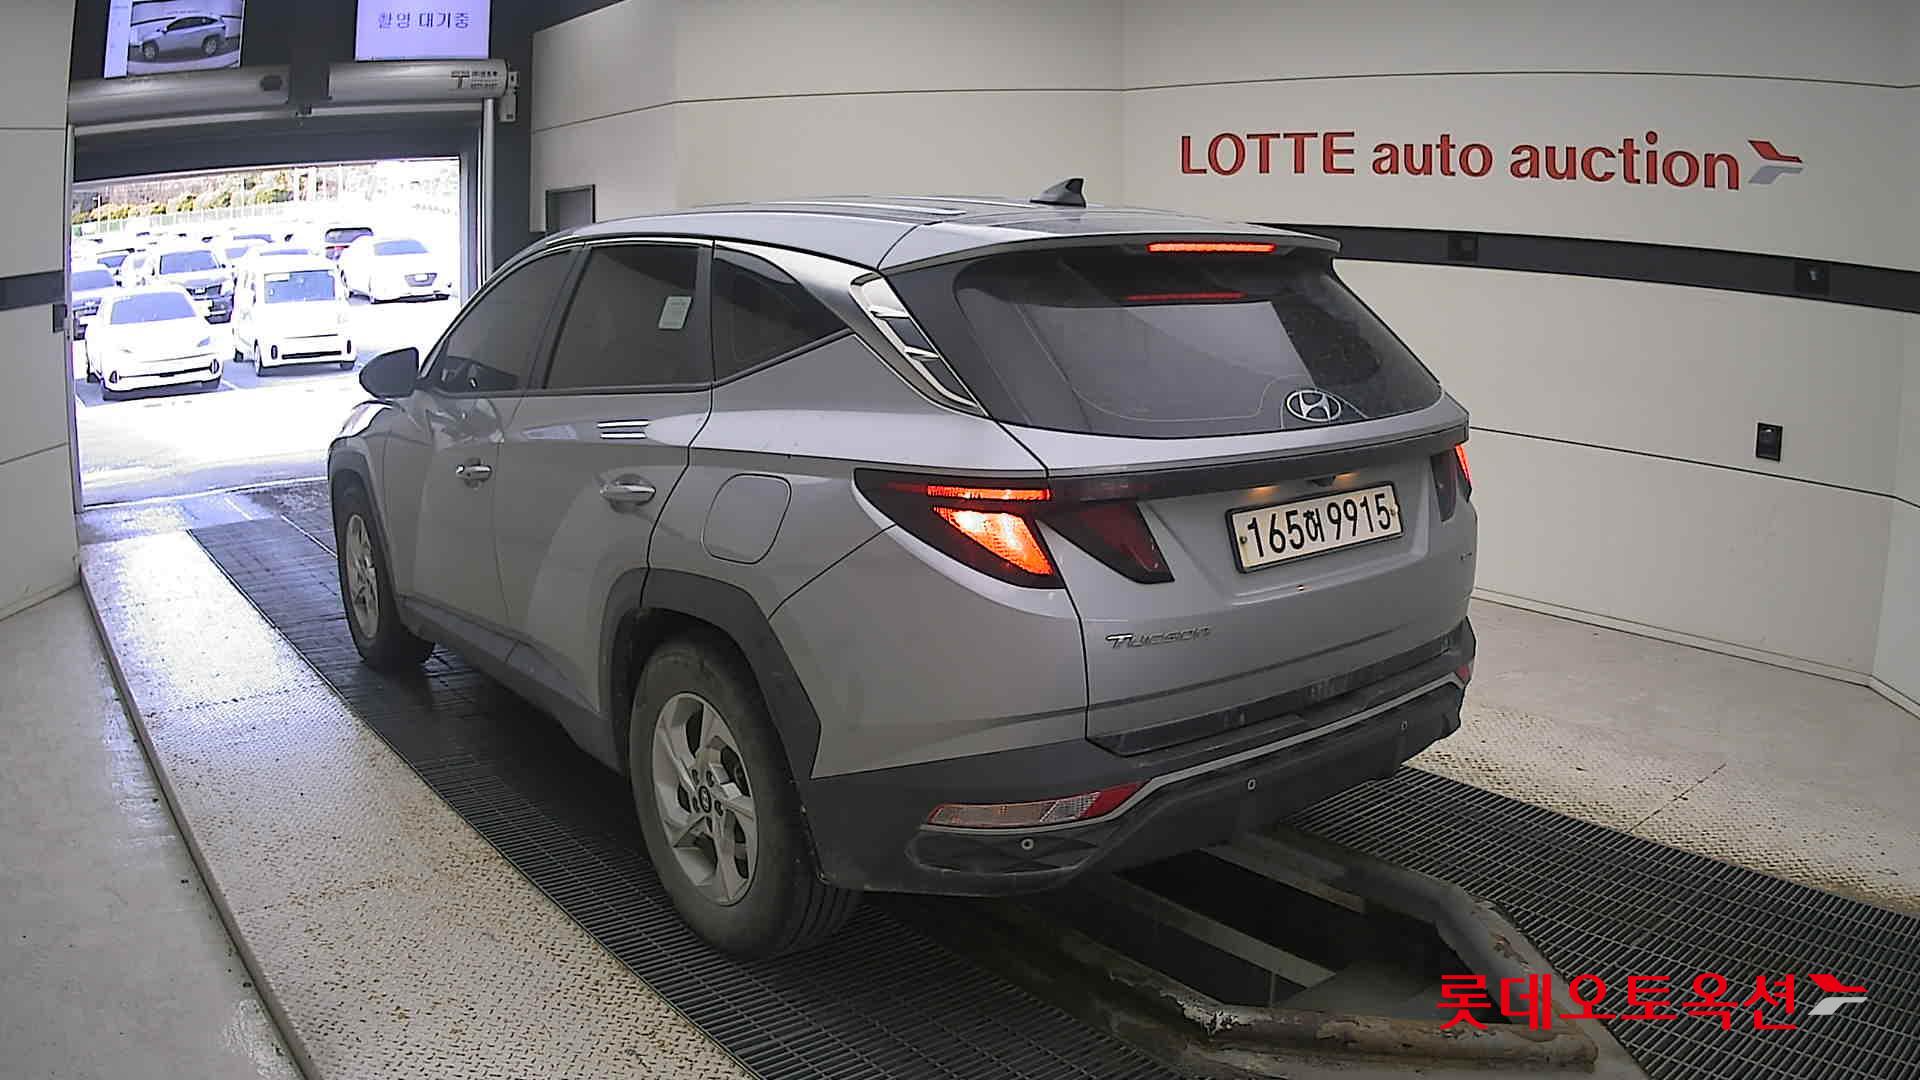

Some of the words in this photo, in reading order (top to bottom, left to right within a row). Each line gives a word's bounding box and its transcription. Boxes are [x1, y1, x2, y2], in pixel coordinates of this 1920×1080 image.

[418, 12, 471, 29] 대기중
[1180, 131, 1356, 176] LOTTE
[1372, 133, 1493, 178] auto
[1510, 130, 1740, 190] auction
[1247, 493, 1391, 557] 165허9915
